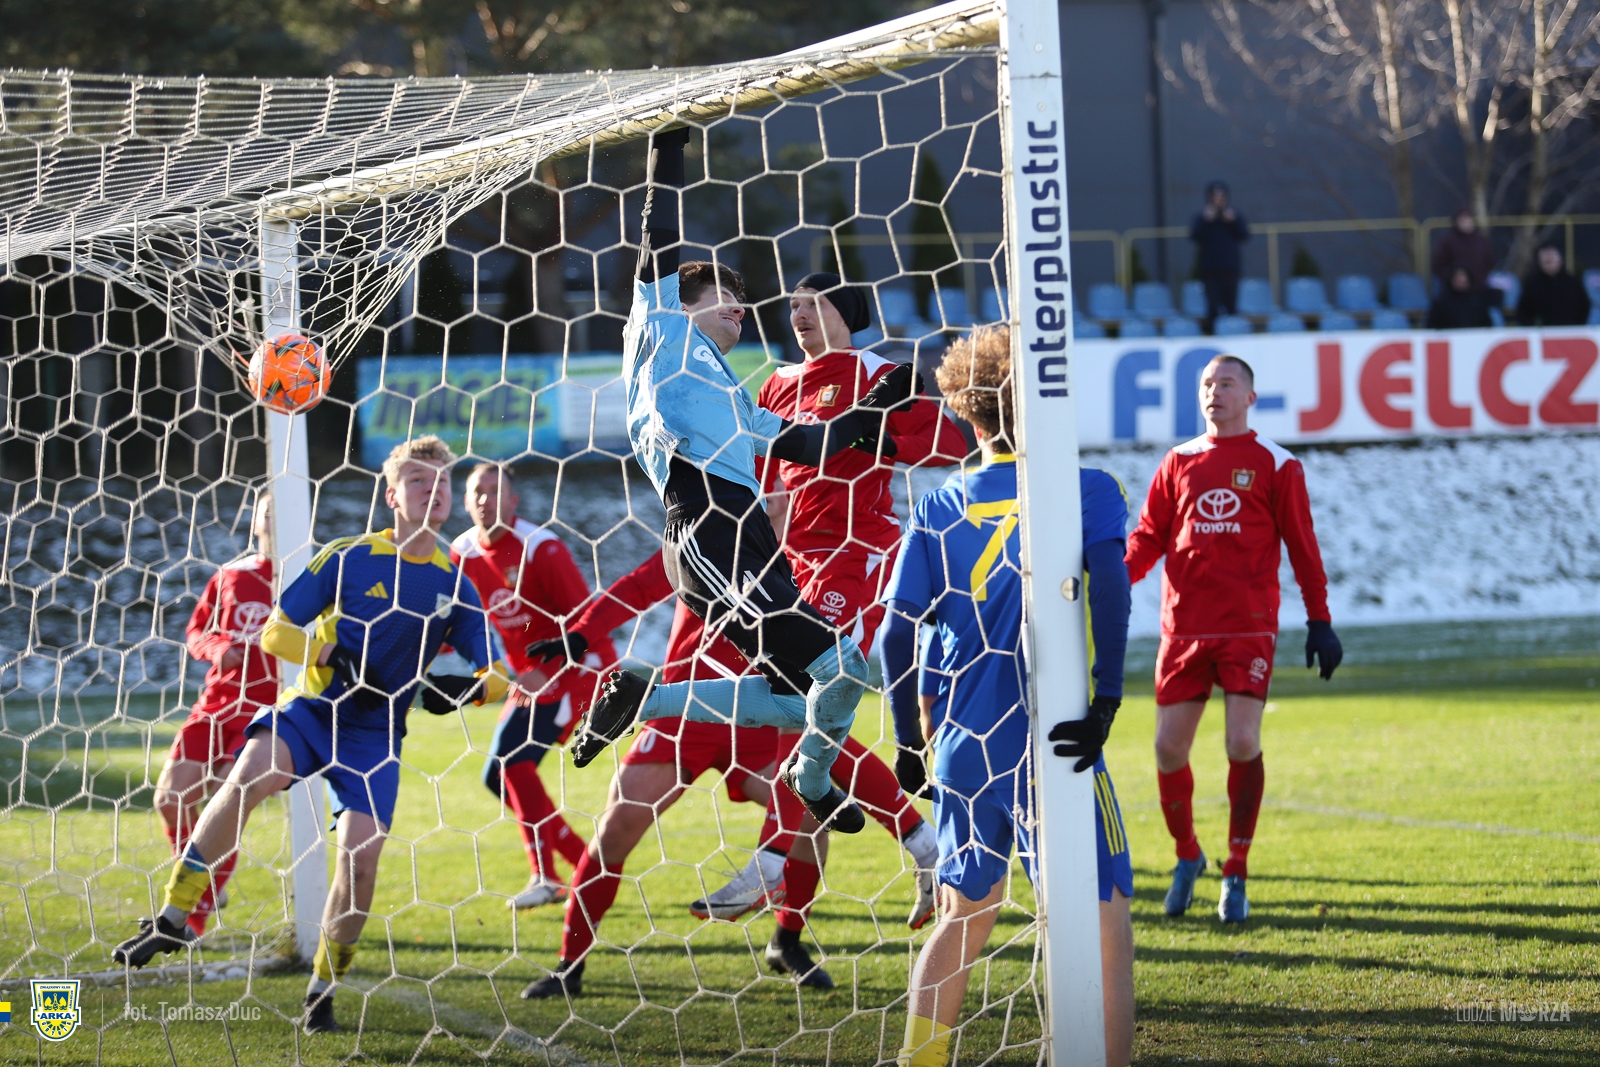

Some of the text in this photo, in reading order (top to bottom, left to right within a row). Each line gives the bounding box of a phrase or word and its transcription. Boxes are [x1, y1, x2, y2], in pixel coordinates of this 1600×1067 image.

[1193, 521, 1242, 534] TOYOTA
[968, 498, 1019, 602] 7
[819, 604, 843, 616] TOYOTA
